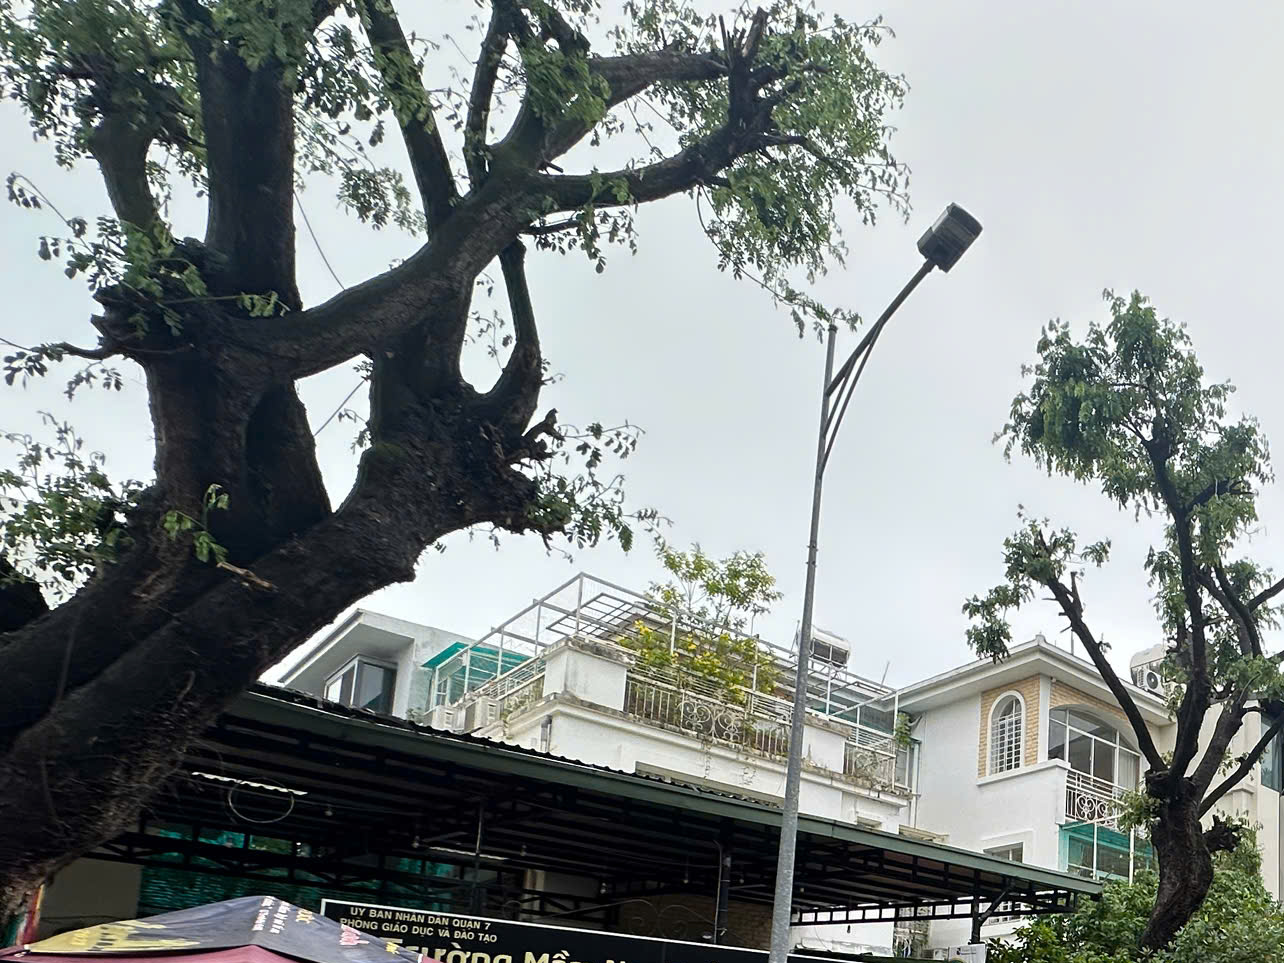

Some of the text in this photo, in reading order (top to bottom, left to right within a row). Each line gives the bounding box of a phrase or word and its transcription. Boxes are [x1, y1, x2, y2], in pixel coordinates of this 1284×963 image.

[369, 909, 393, 921] BAN
[485, 922, 491, 931] 7
[382, 921, 408, 934] GIÁO
[412, 926, 434, 937] DỤC
[438, 926, 450, 938] VÀ
[454, 928, 475, 940] ĐÀO
[478, 933, 498, 944] TẠO
